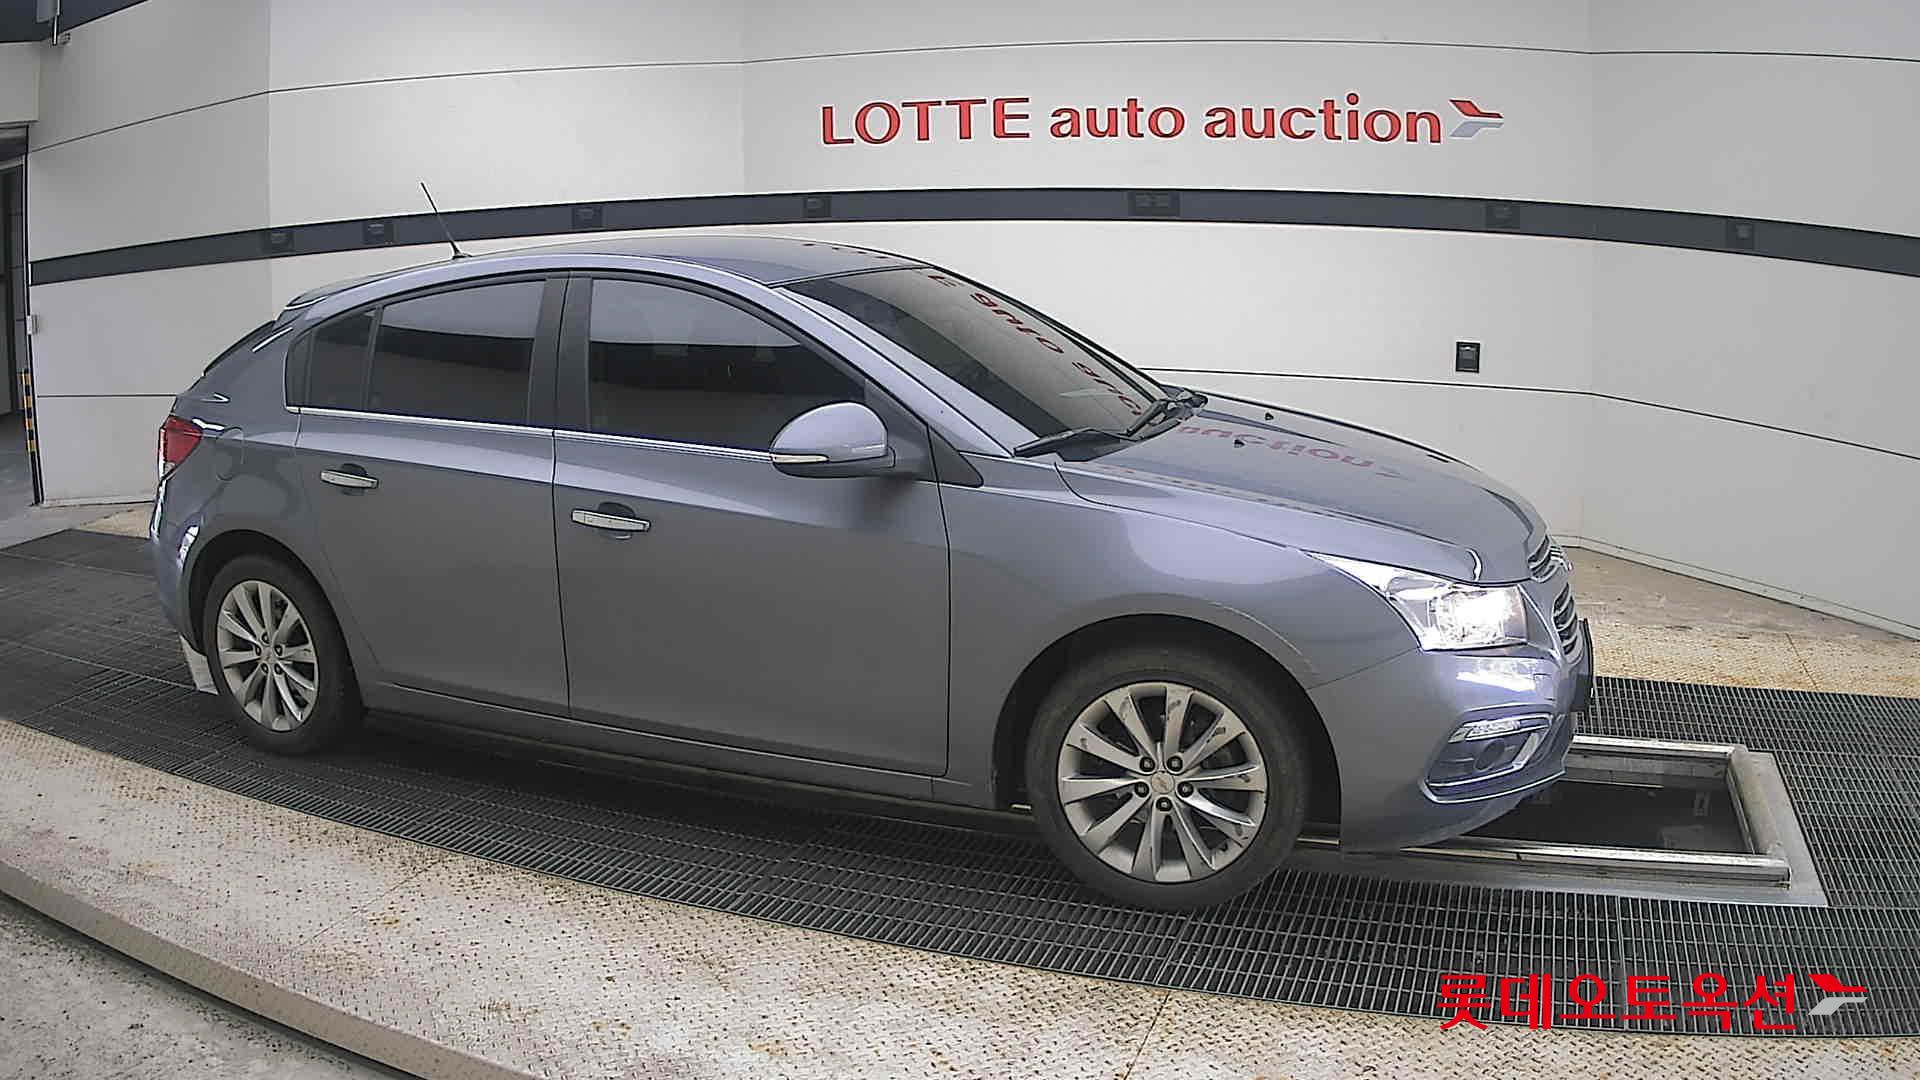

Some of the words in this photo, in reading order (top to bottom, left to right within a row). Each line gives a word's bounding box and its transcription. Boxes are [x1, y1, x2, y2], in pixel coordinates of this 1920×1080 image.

[822, 97, 1030, 145] LOTTE
[1050, 97, 1186, 138] auto
[1205, 93, 1442, 144] auction
